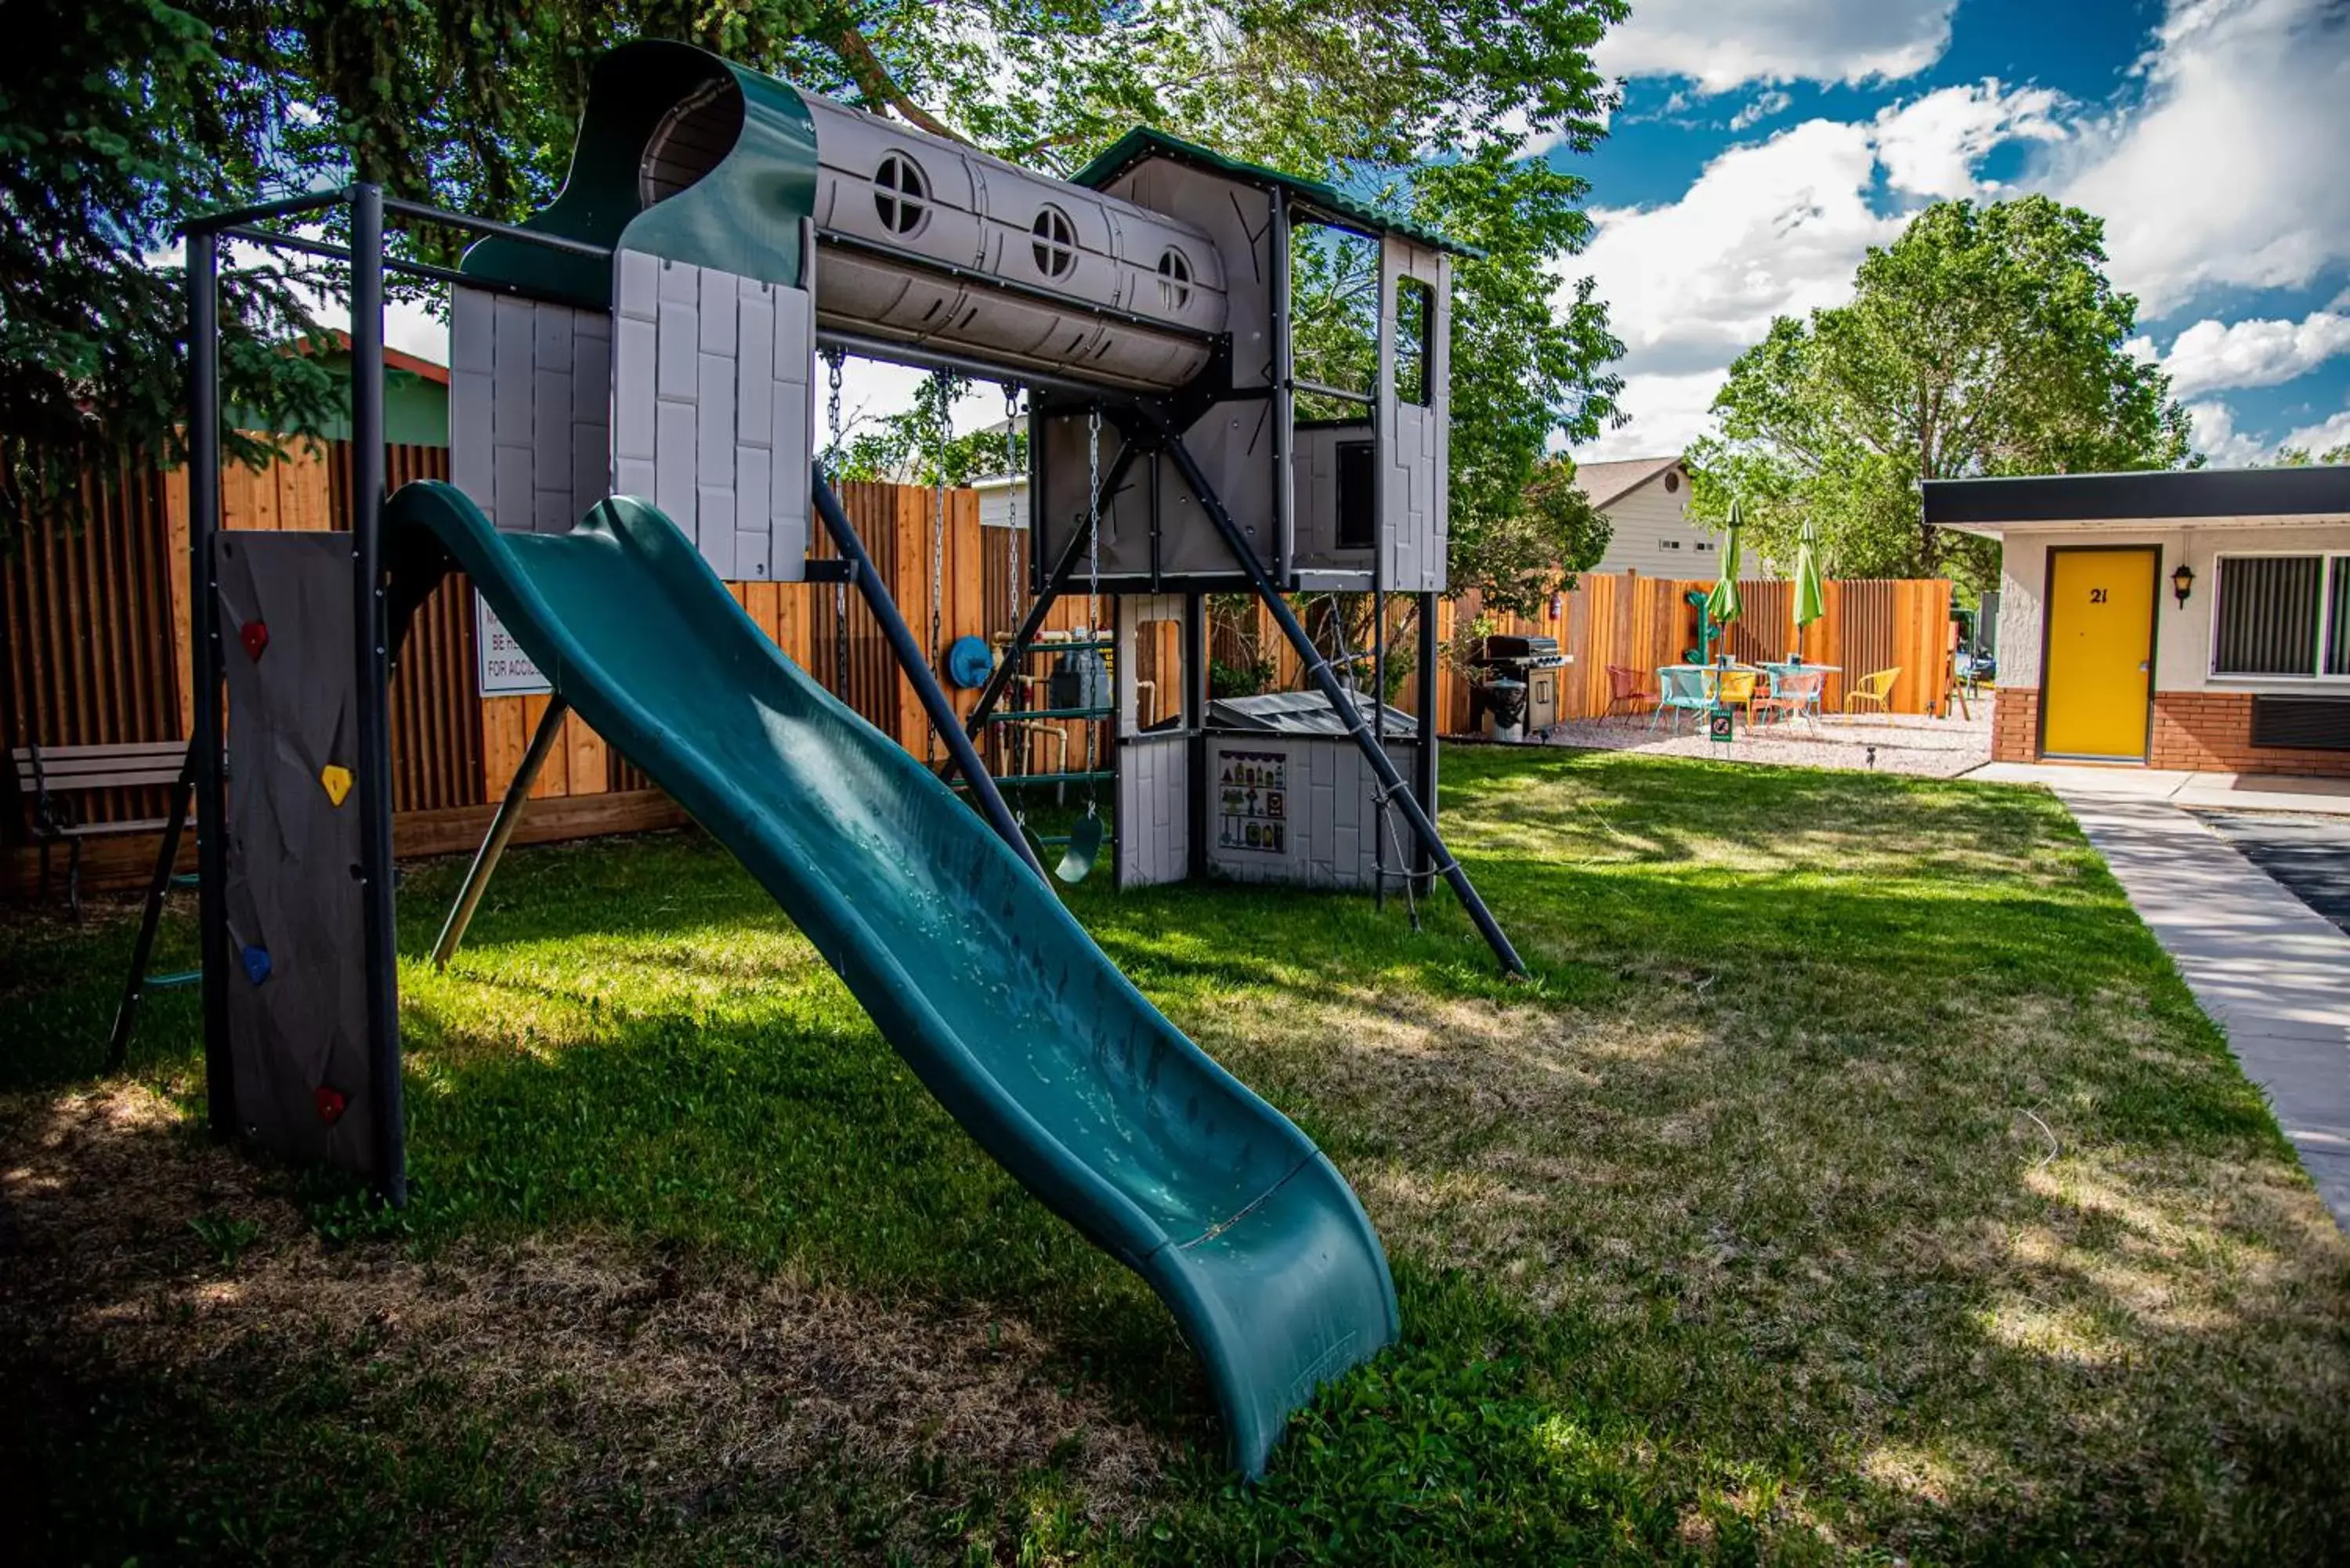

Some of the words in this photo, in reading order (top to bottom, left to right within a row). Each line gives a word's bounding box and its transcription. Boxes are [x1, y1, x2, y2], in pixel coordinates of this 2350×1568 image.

[2089, 588, 2108, 604] 21
[493, 634, 504, 651] BE
[488, 660, 506, 677] FOR
